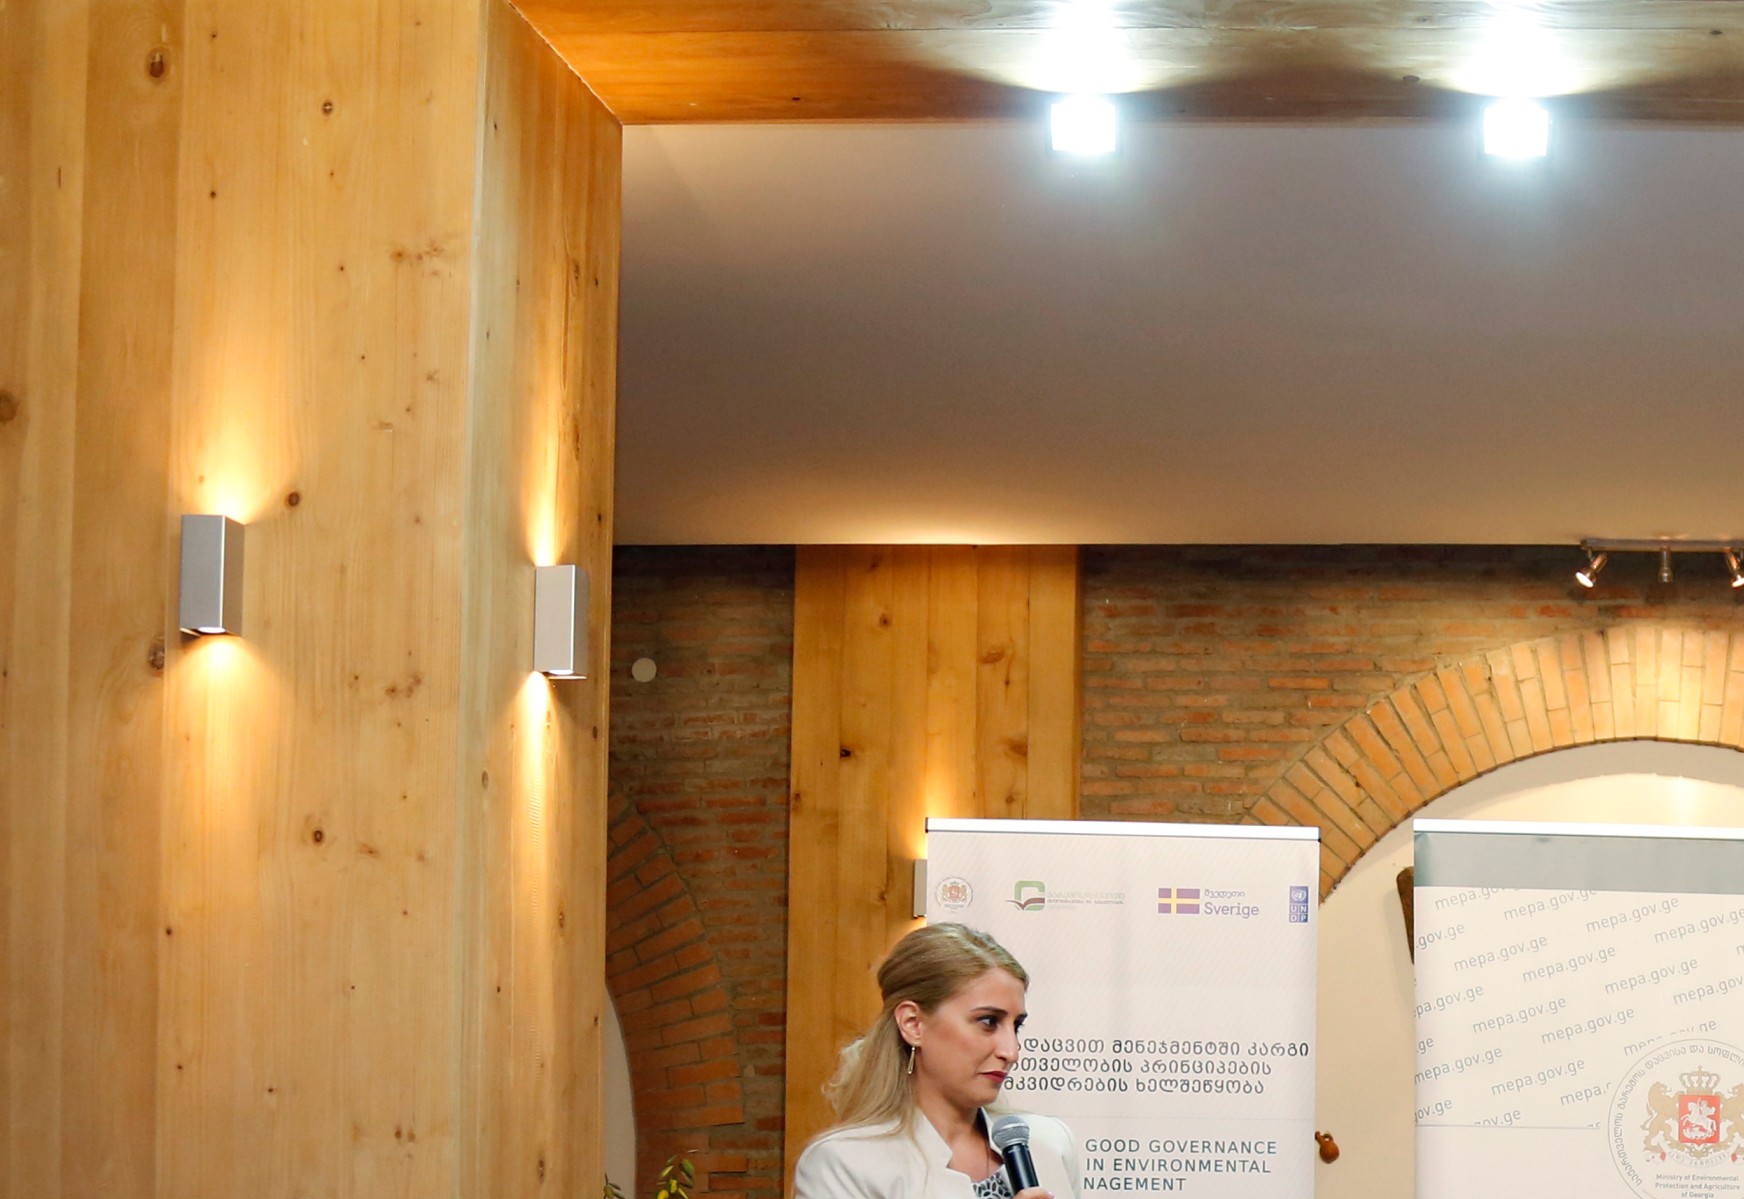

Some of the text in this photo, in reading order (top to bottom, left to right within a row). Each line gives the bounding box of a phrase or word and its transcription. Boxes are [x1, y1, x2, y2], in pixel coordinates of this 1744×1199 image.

[1204, 901, 1260, 919] Sverige
[1586, 896, 1679, 933] mepa.gov.ge
[1454, 935, 1548, 971] mepa.gov.ge
[1522, 945, 1616, 982] mepa.gov.ge
[1605, 957, 1698, 995] mepa.gov.ge
[1472, 996, 1567, 1034] mepa.gov.ge
[1541, 1007, 1635, 1044] mepa.gov.ge
[1112, 1039, 1240, 1055] მენეჯმენტში
[1248, 1042, 1309, 1057] კარგი
[1690, 1044, 1704, 1054] და
[1140, 1059, 1272, 1075] პრინციპების
[1414, 1046, 1503, 1084] mepa.gov.ge
[1491, 1058, 1585, 1095] mepa.gov.ge
[1136, 1078, 1264, 1094] ხელშეწყობა
[1085, 1138, 1277, 1154] GOOD GOVERNANCE
[1086, 1158, 1271, 1173] IN ENVIRONMENTAL
[1703, 1183, 1740, 1191] Agriculture
